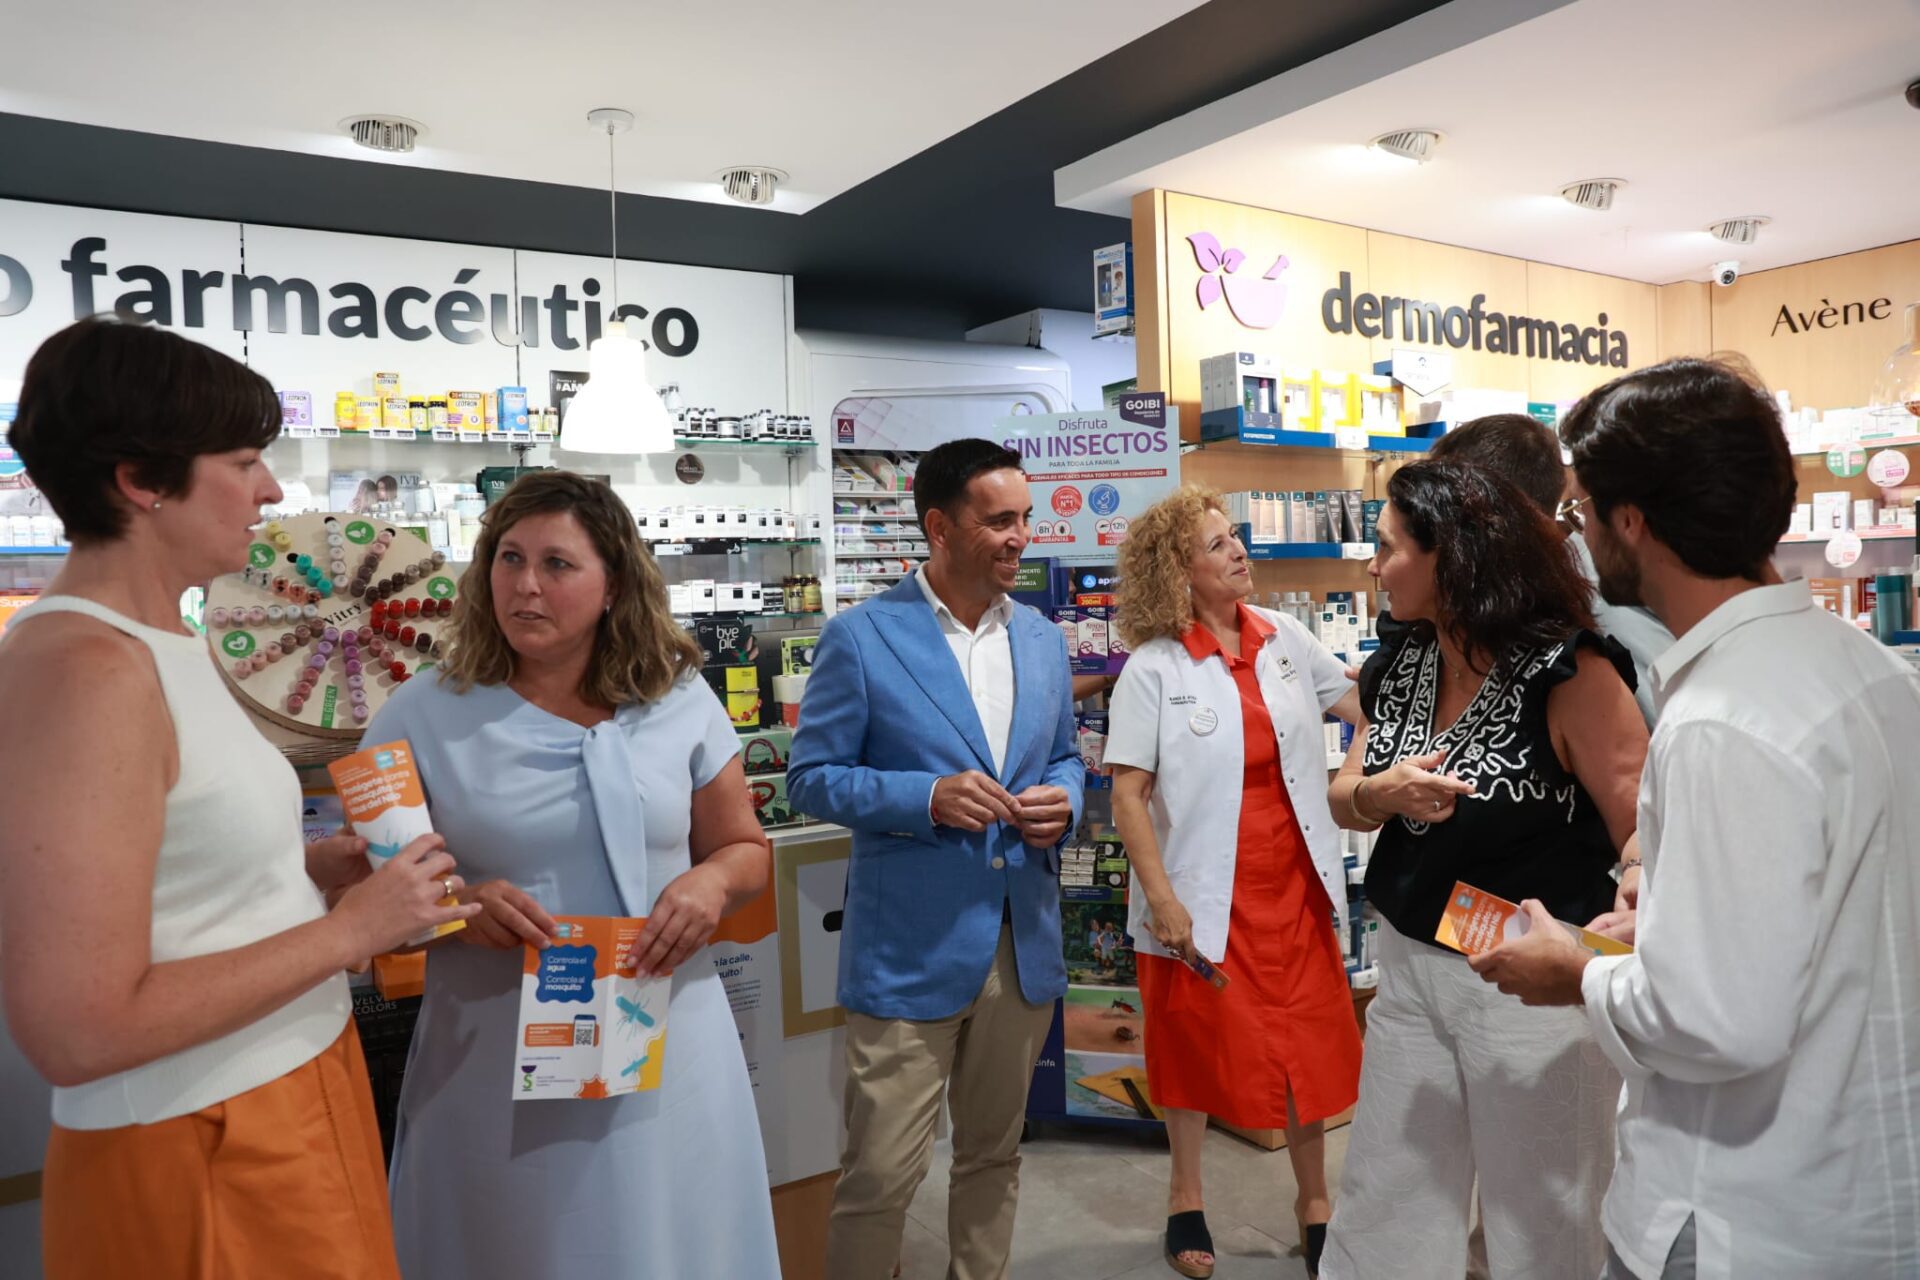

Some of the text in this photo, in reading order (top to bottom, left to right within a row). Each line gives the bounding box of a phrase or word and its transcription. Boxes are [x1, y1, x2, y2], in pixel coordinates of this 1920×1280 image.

[61, 236, 699, 358] farmacéutico
[1321, 271, 1629, 369] dermofarmacia
[1771, 296, 1892, 337] Avène
[1125, 399, 1160, 410] GOIBI
[1058, 417, 1108, 431] Disfruta
[1047, 431, 1168, 458] INSECTOS
[1038, 525, 1050, 533] 8h
[1112, 521, 1126, 530] 12h
[323, 603, 361, 625] Vitry
[717, 624, 739, 640] bye
[719, 637, 736, 653] pic
[547, 956, 579, 965] Controla
[720, 956, 728, 966] la
[728, 953, 753, 965] calle,
[545, 975, 578, 983] Controla
[544, 983, 582, 992] mosquito
[354, 1002, 397, 1015] COLORS
